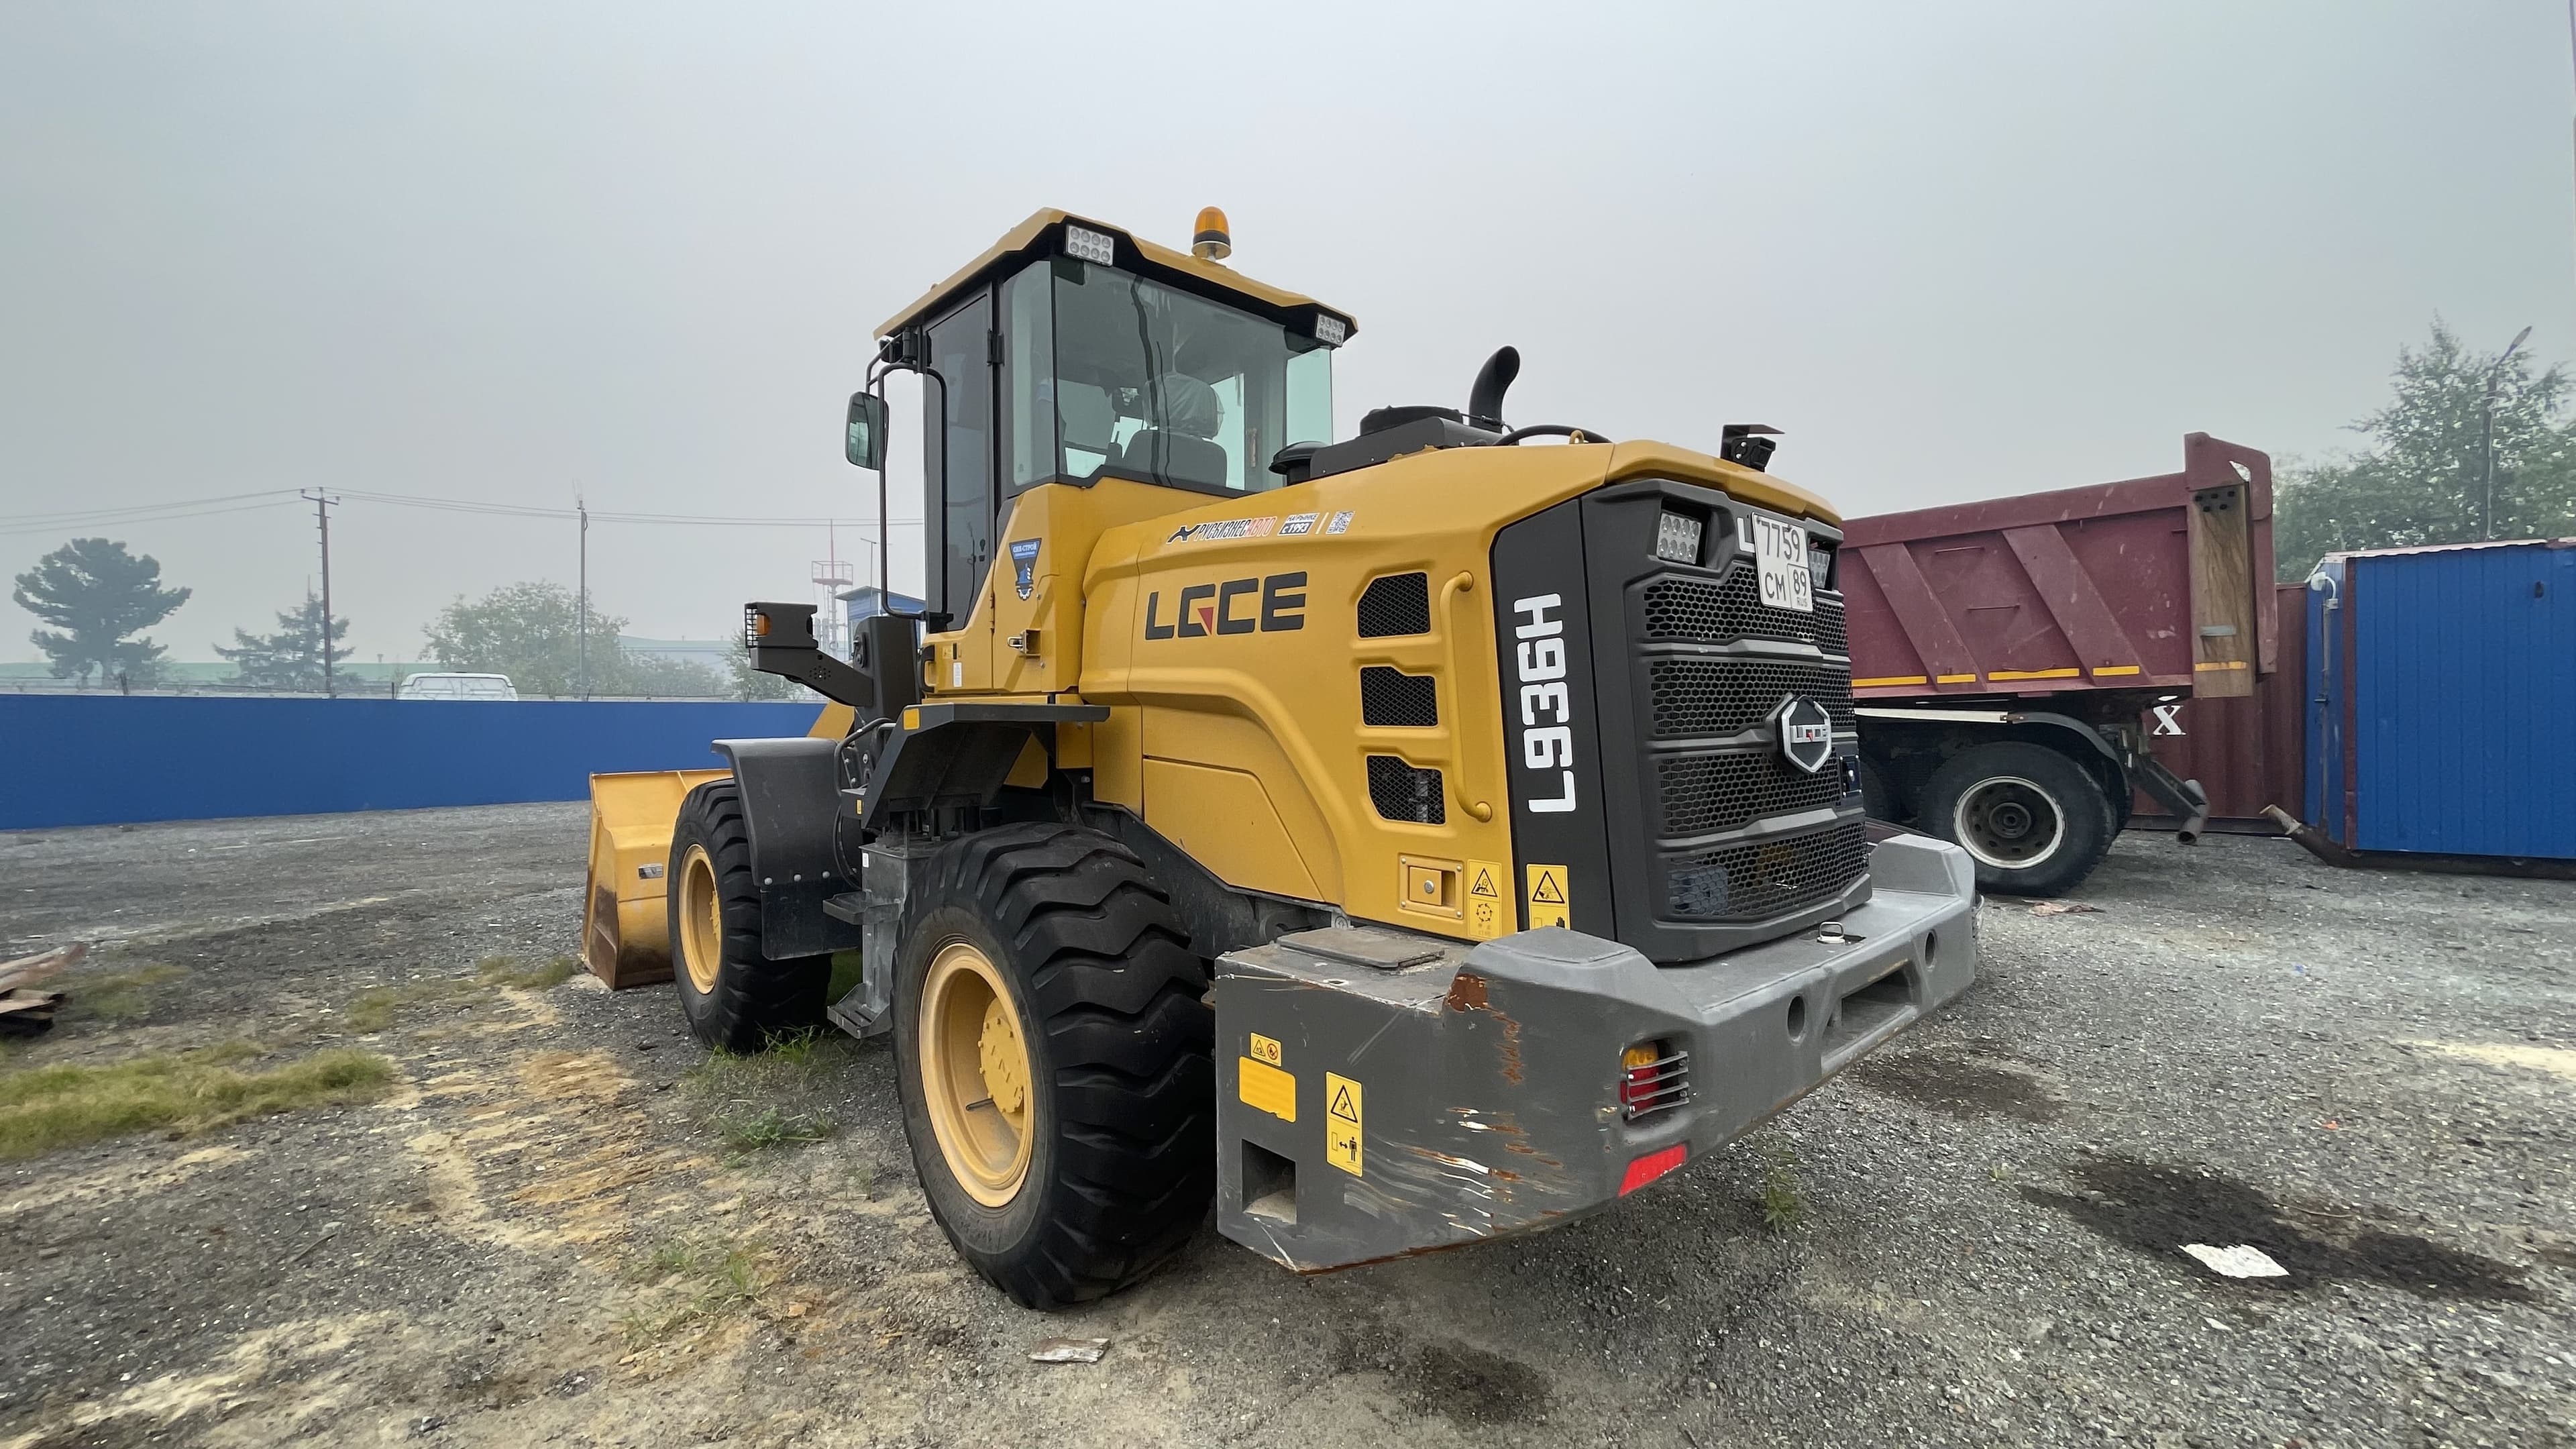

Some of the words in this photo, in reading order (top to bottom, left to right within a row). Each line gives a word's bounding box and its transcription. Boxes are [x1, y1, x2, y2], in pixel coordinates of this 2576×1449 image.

[1288, 523, 1309, 533] 1993
[1737, 517, 1756, 553] L
[1761, 520, 1801, 562] 7759
[1793, 570, 1807, 596] 89
[1796, 596, 1808, 606] RUS
[1514, 593, 1576, 812] L936H
